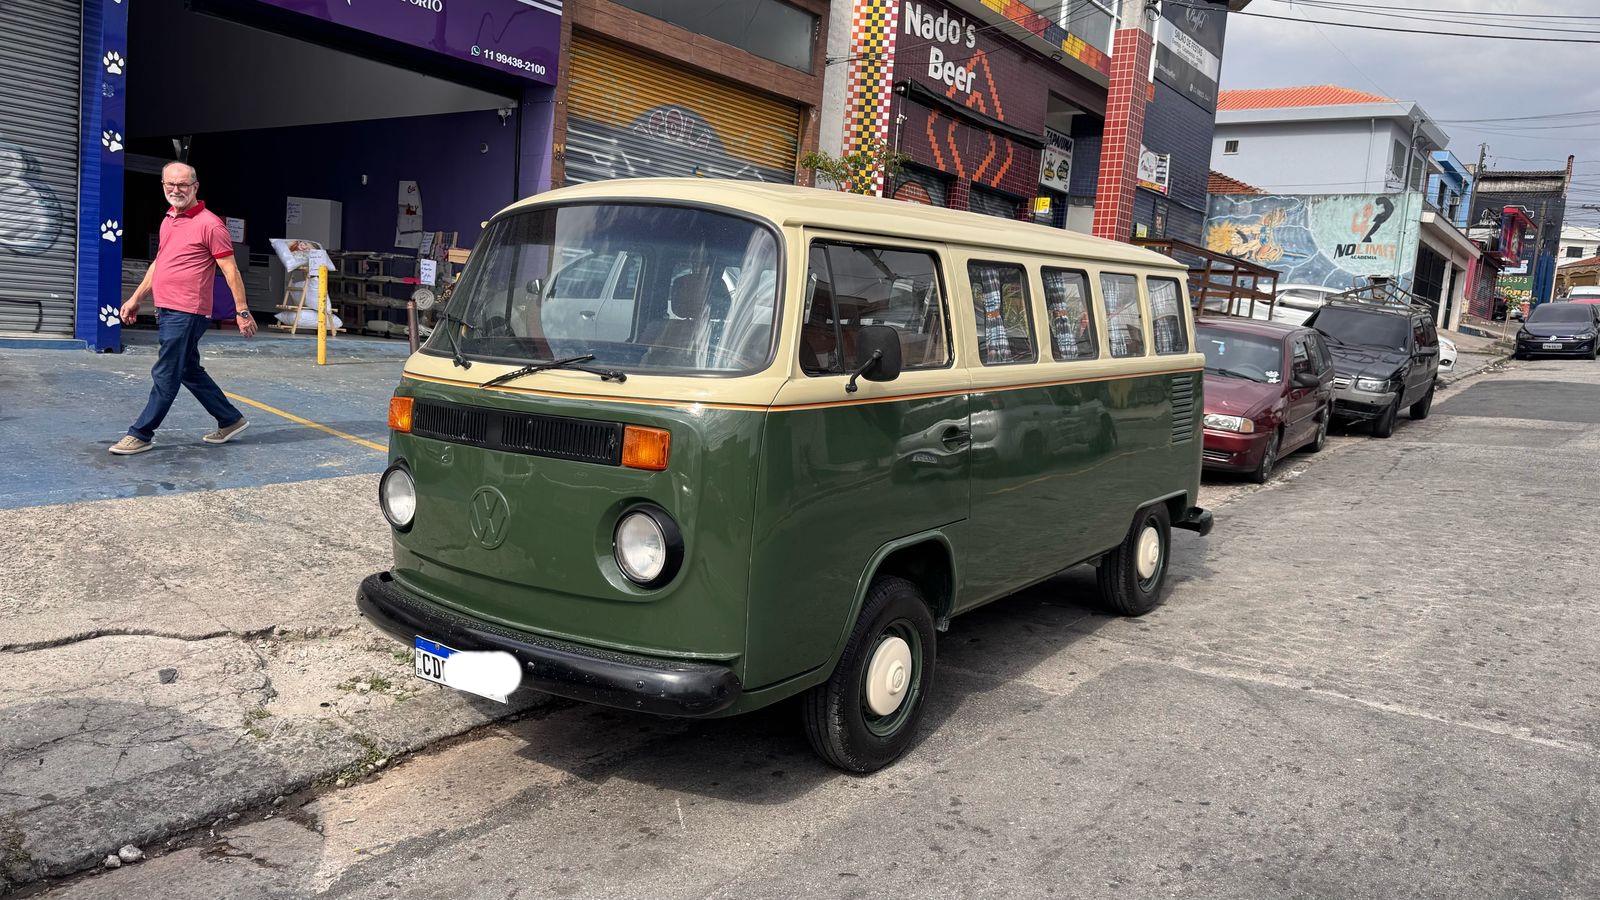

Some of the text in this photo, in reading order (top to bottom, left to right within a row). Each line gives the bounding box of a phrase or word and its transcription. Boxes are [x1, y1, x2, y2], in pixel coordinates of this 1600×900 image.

[905, 1, 976, 48] Nado's
[483, 49, 546, 75] 11 99438-2100
[928, 46, 976, 94] Beer
